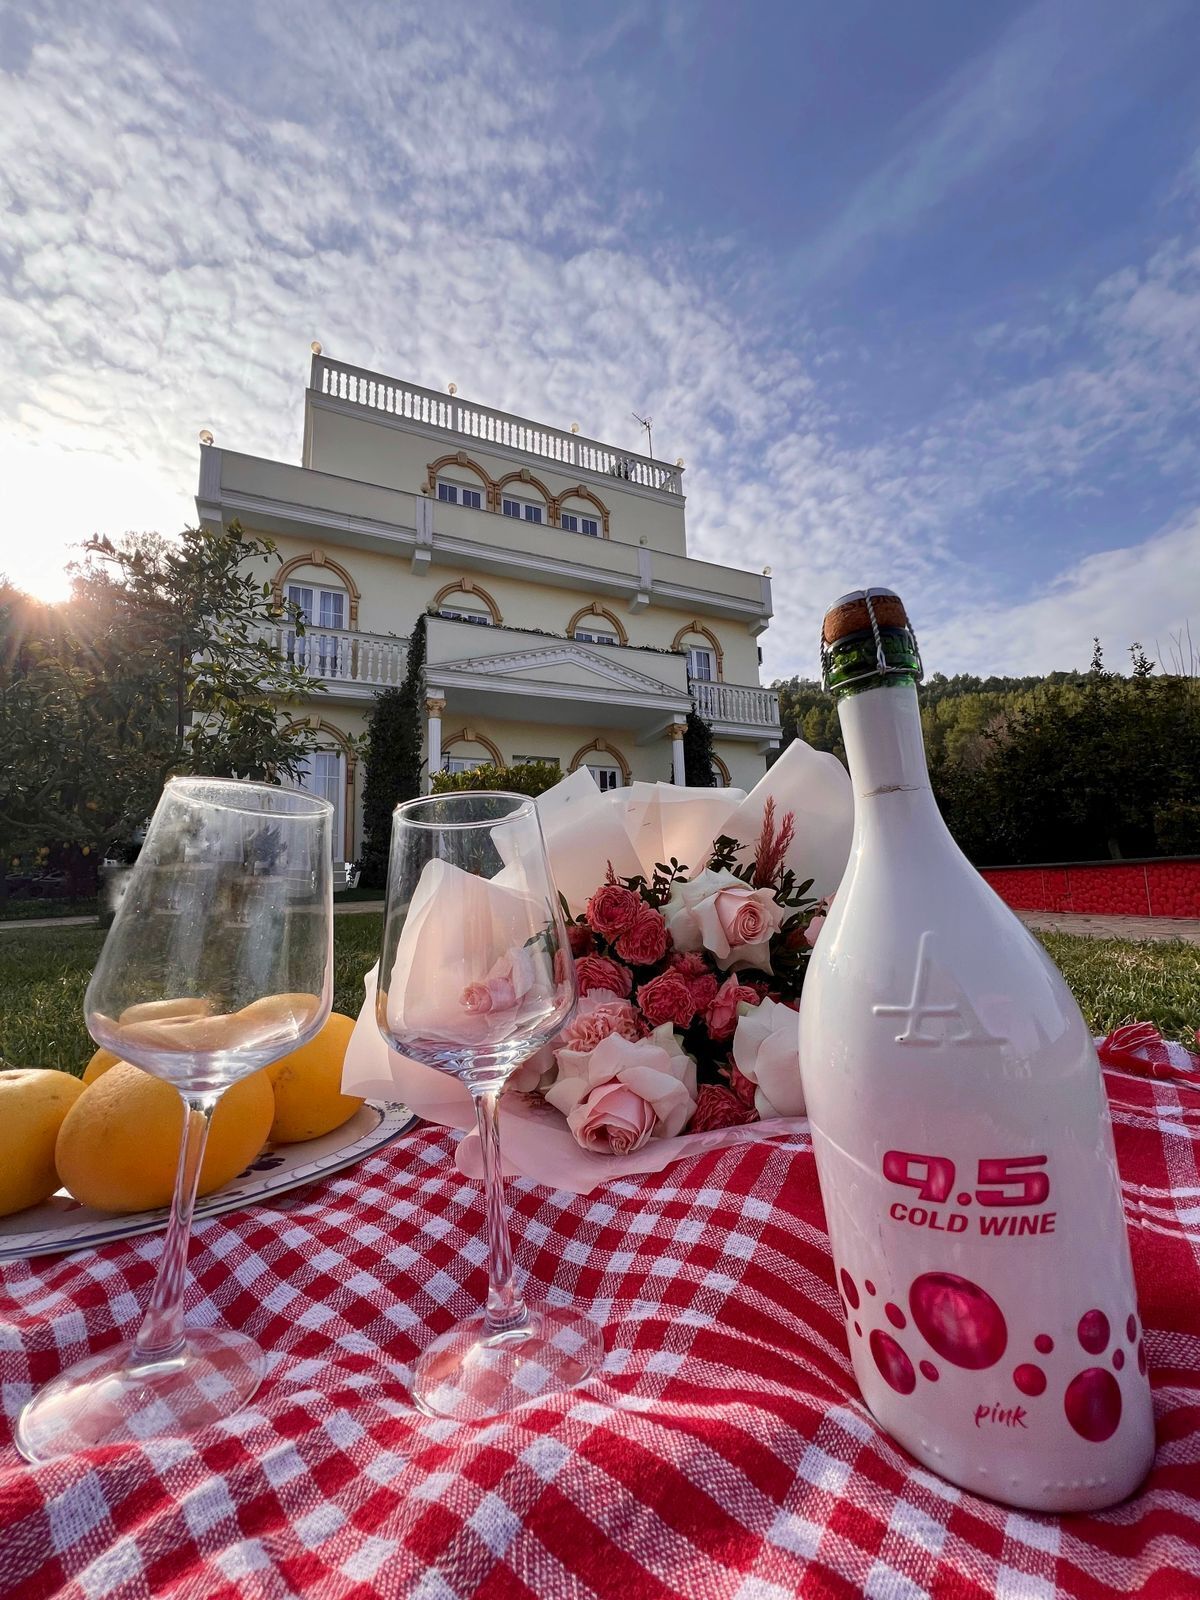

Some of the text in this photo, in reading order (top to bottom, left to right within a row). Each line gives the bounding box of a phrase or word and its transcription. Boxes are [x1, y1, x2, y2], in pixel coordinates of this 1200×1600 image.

[882, 1150, 1050, 1207] 9.5
[889, 1202, 1057, 1236] COLD WINE
[973, 1402, 1029, 1429] pink
